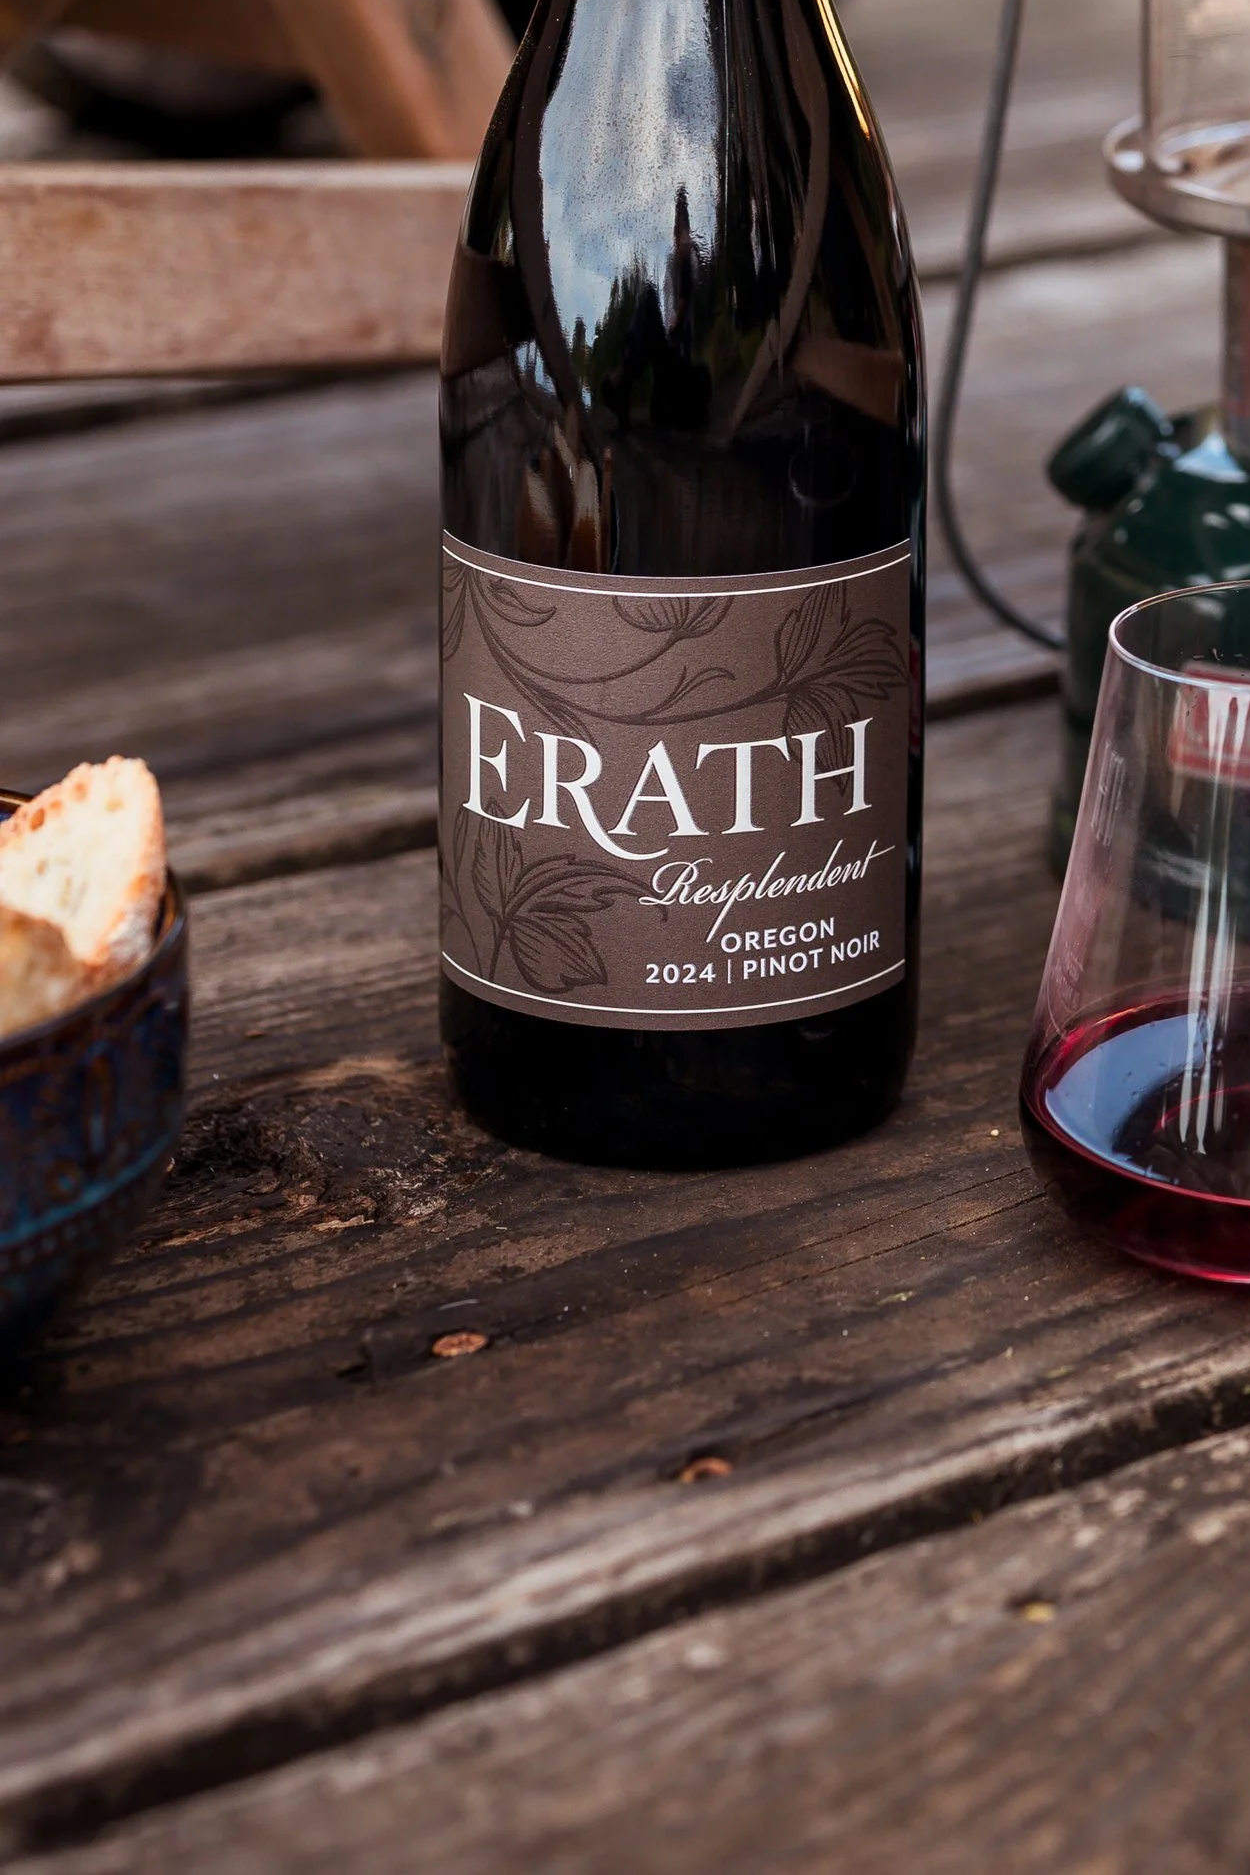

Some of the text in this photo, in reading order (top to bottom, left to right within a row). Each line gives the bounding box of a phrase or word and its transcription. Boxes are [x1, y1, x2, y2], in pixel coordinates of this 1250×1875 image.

[462, 692, 873, 860] ERATH
[638, 839, 896, 943] Resplendent
[645, 930, 880, 984] 2024 PINOT NOIR
[720, 917, 835, 954] OREGON
